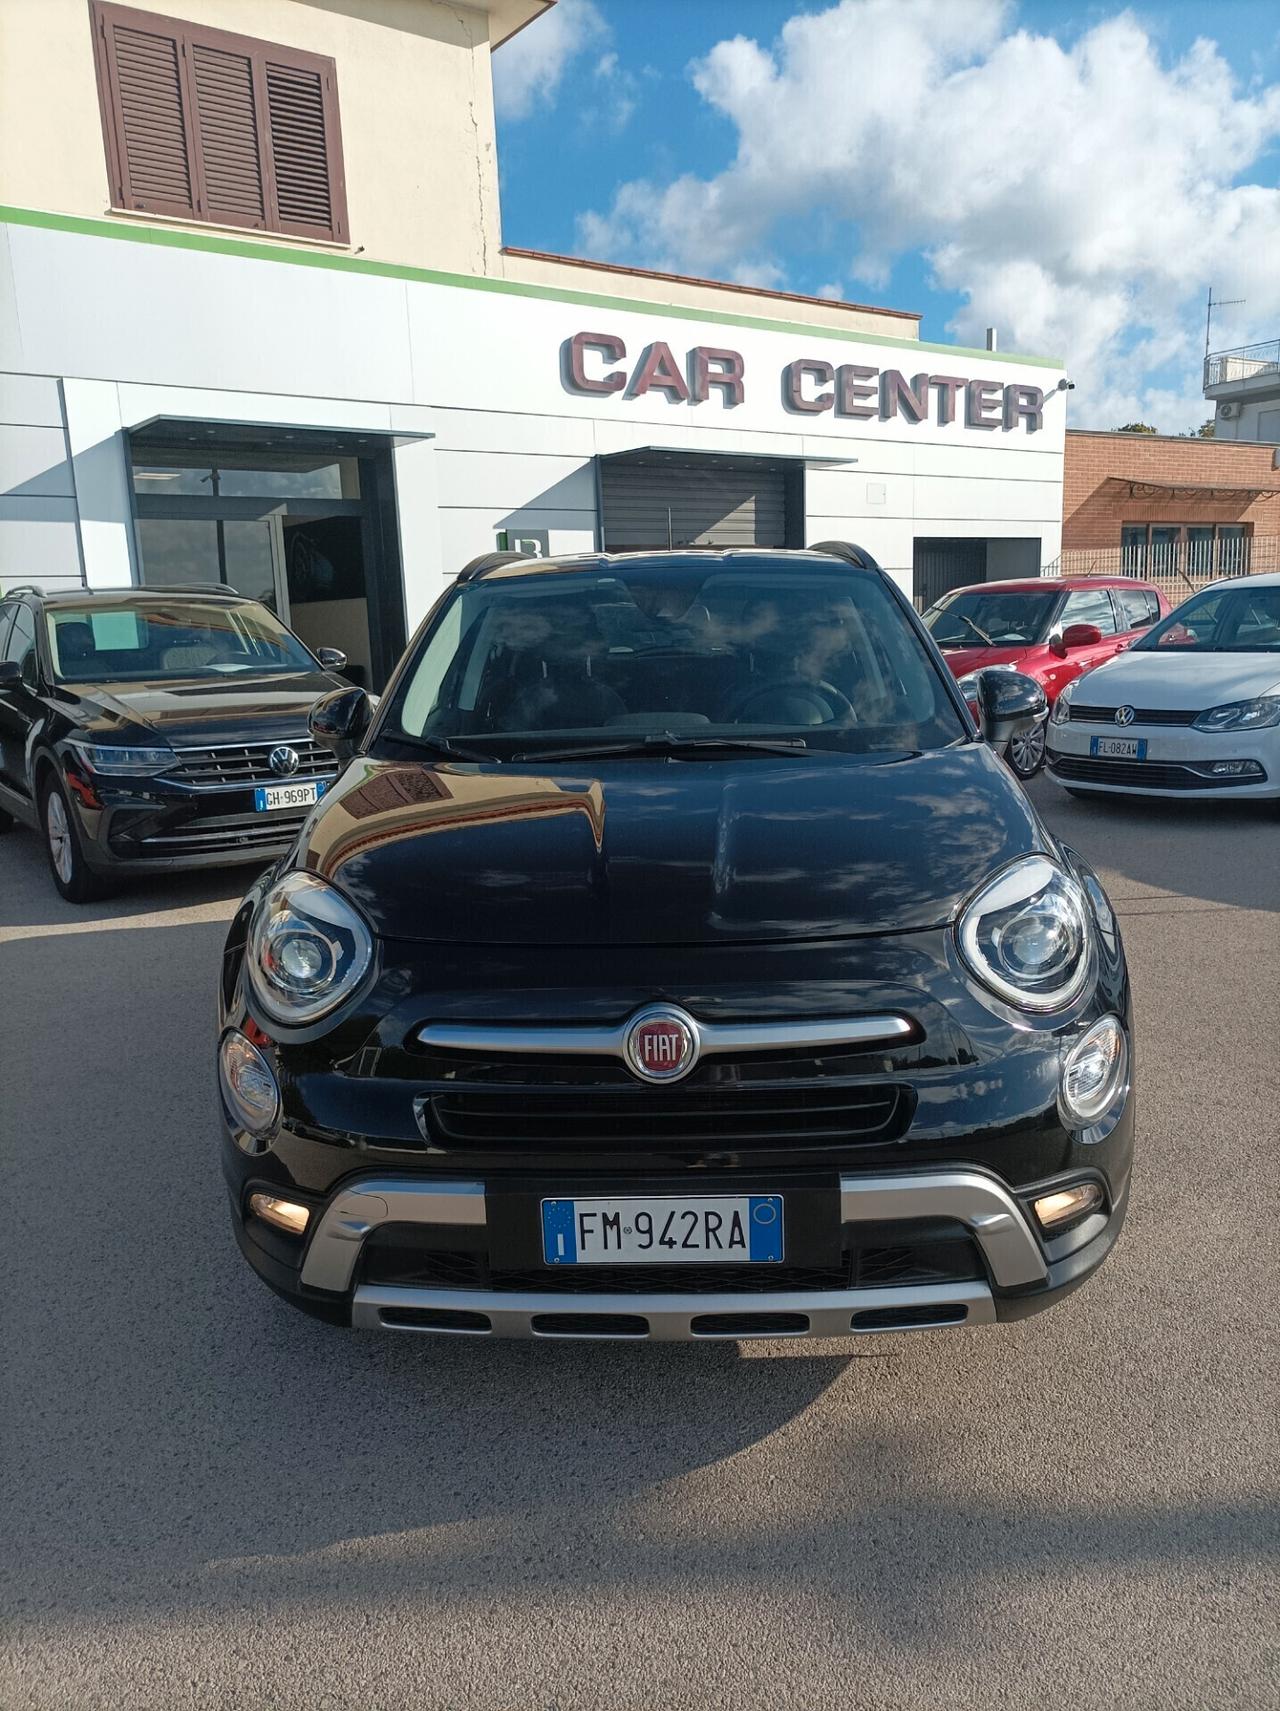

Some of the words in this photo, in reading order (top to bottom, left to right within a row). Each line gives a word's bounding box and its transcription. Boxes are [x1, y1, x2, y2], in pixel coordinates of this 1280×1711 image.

[559, 331, 745, 409] CAR
[781, 358, 1044, 435] CENTER
[644, 1034, 679, 1062] FIAT
